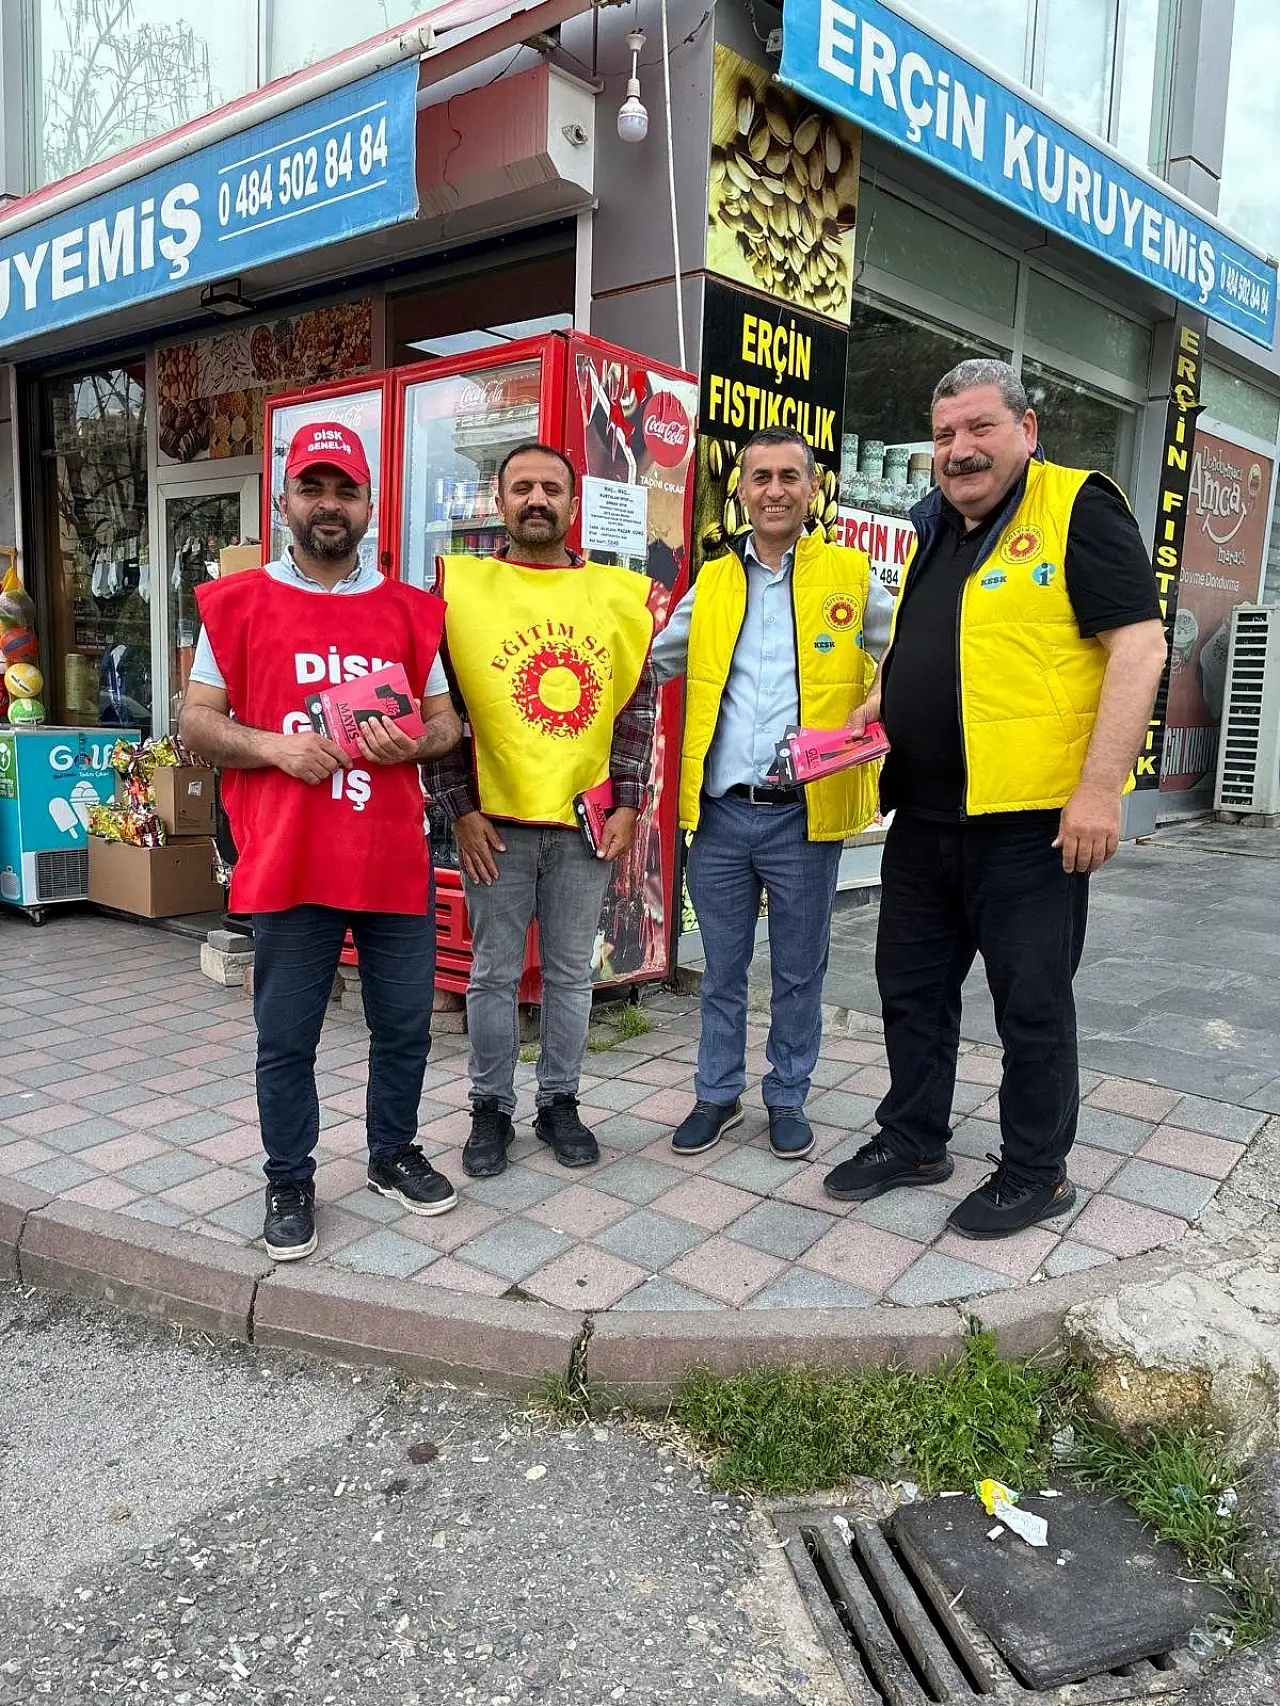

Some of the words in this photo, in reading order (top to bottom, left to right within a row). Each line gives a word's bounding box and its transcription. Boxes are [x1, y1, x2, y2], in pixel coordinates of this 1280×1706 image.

[218, 182, 230, 226] 0
[235, 163, 273, 219] 484
[279, 146, 318, 205] 502
[324, 131, 353, 189] 84
[359, 116, 388, 176] 84
[741, 313, 812, 384] ERÇİN
[1186, 451, 1242, 518] Amca
[880, 567, 899, 586] 484
[491, 618, 575, 673] EĞİTİM
[338, 702, 360, 742] MAYIS
